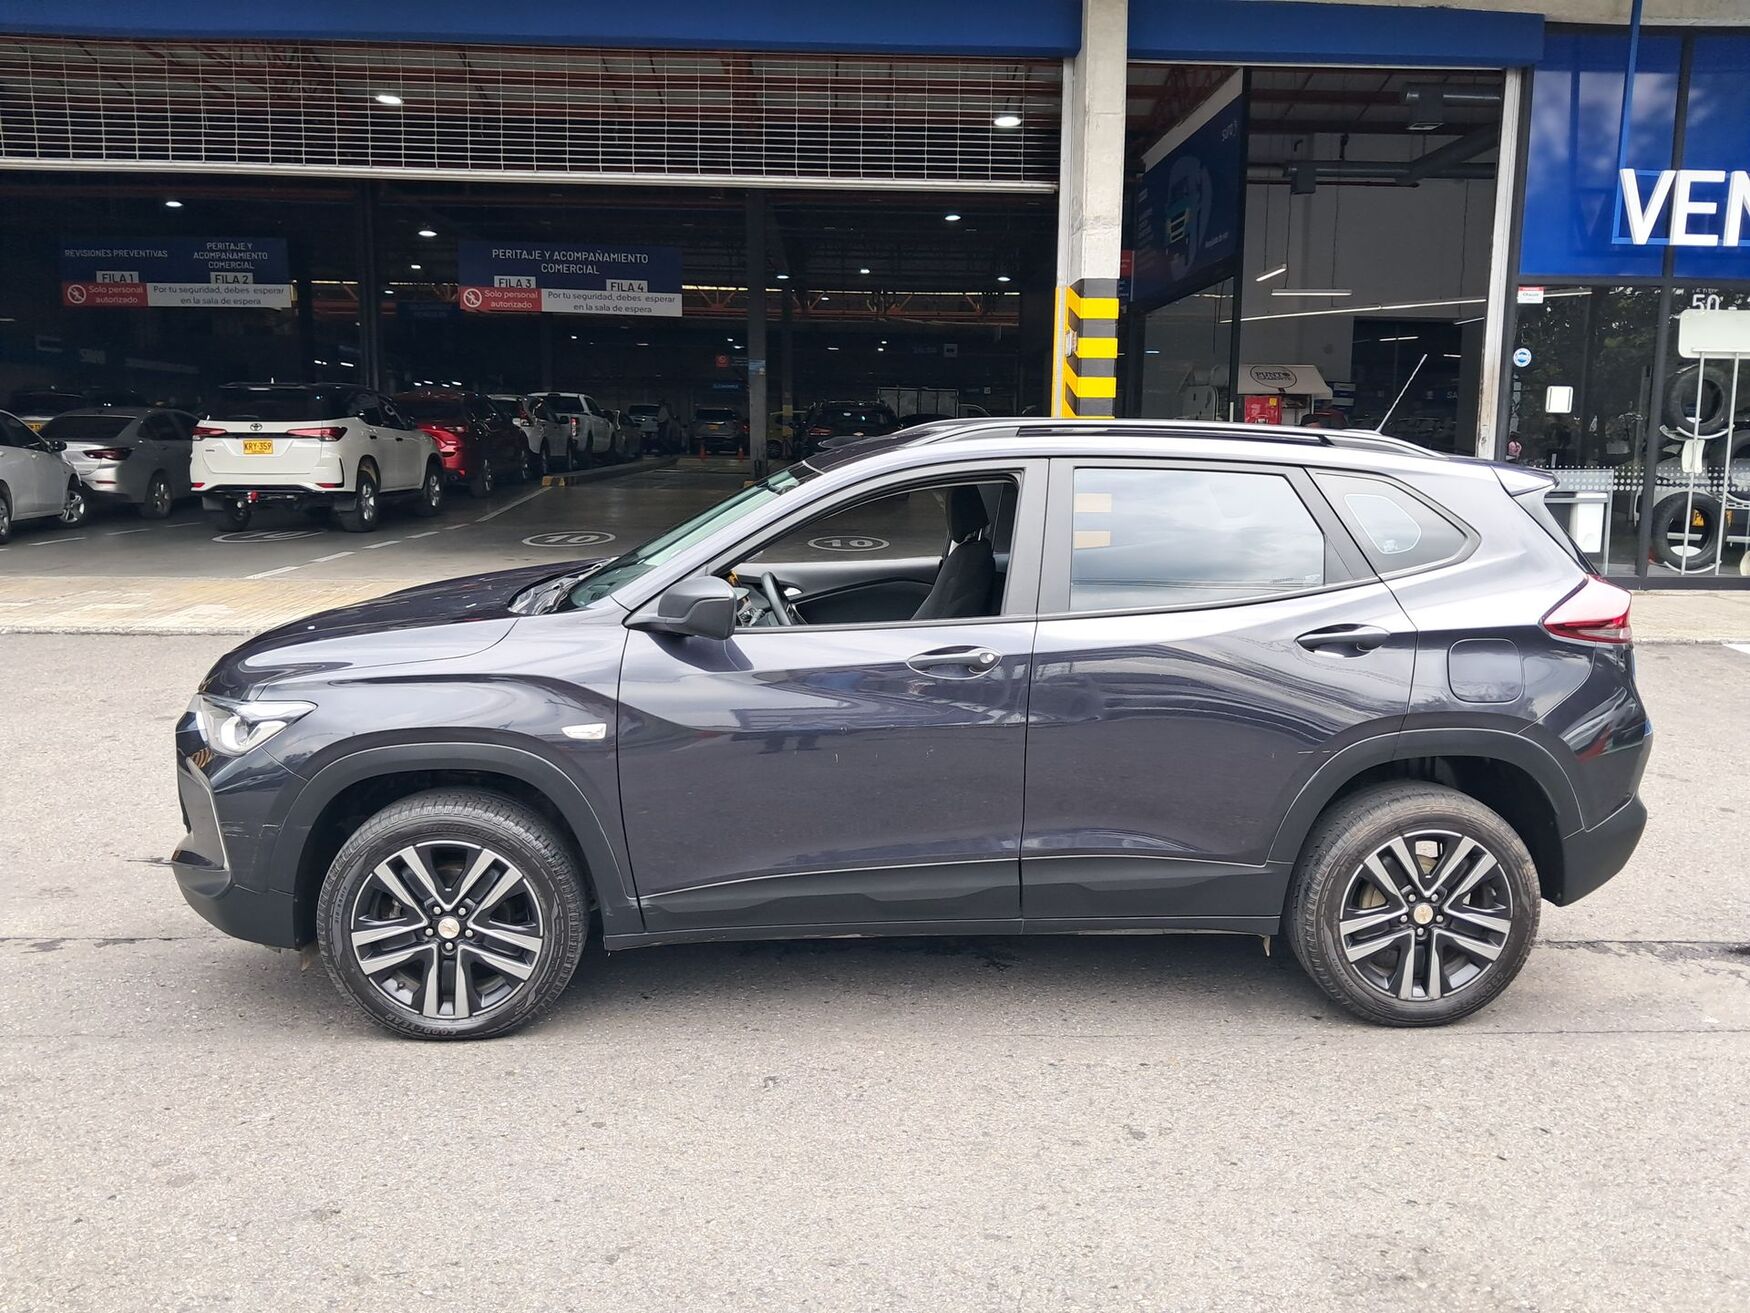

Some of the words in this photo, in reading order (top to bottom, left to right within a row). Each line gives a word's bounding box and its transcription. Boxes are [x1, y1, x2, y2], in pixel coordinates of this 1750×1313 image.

[206, 242, 246, 251] PERITAJE
[64, 249, 112, 258] REVISIONES
[113, 249, 168, 258] PREVENTIVAS
[492, 249, 542, 260] PERITAJE
[544, 251, 551, 261] Y
[553, 250, 649, 264] ACOMPAÑAMIENTO
[208, 261, 255, 270] COMERCIAL
[541, 264, 600, 275] COMERCIAL
[101, 273, 127, 283] FILA
[215, 275, 240, 284] FILA
[498, 278, 524, 288] FILA
[525, 279, 532, 288] 3
[89, 285, 108, 294] Solo
[109, 286, 143, 296] personal
[153, 285, 168, 294] Por
[224, 286, 250, 294] debes
[253, 288, 284, 296] esperar
[610, 282, 635, 292] FILA
[637, 283, 644, 292] 4
[95, 295, 138, 304] autorizado
[484, 289, 503, 298] Solo
[503, 290, 539, 300] personal
[547, 291, 562, 299] Por
[562, 292, 571, 300] tu
[616, 293, 641, 302] debes
[645, 296, 676, 304] esperar
[203, 297, 219, 305] sala
[221, 297, 232, 305] de
[233, 298, 261, 307] espera
[490, 299, 533, 309] autorizado
[595, 304, 611, 312] sala
[612, 304, 623, 312] de
[624, 305, 652, 314] espera
[541, 533, 598, 544] 10
[821, 539, 872, 548] 10
